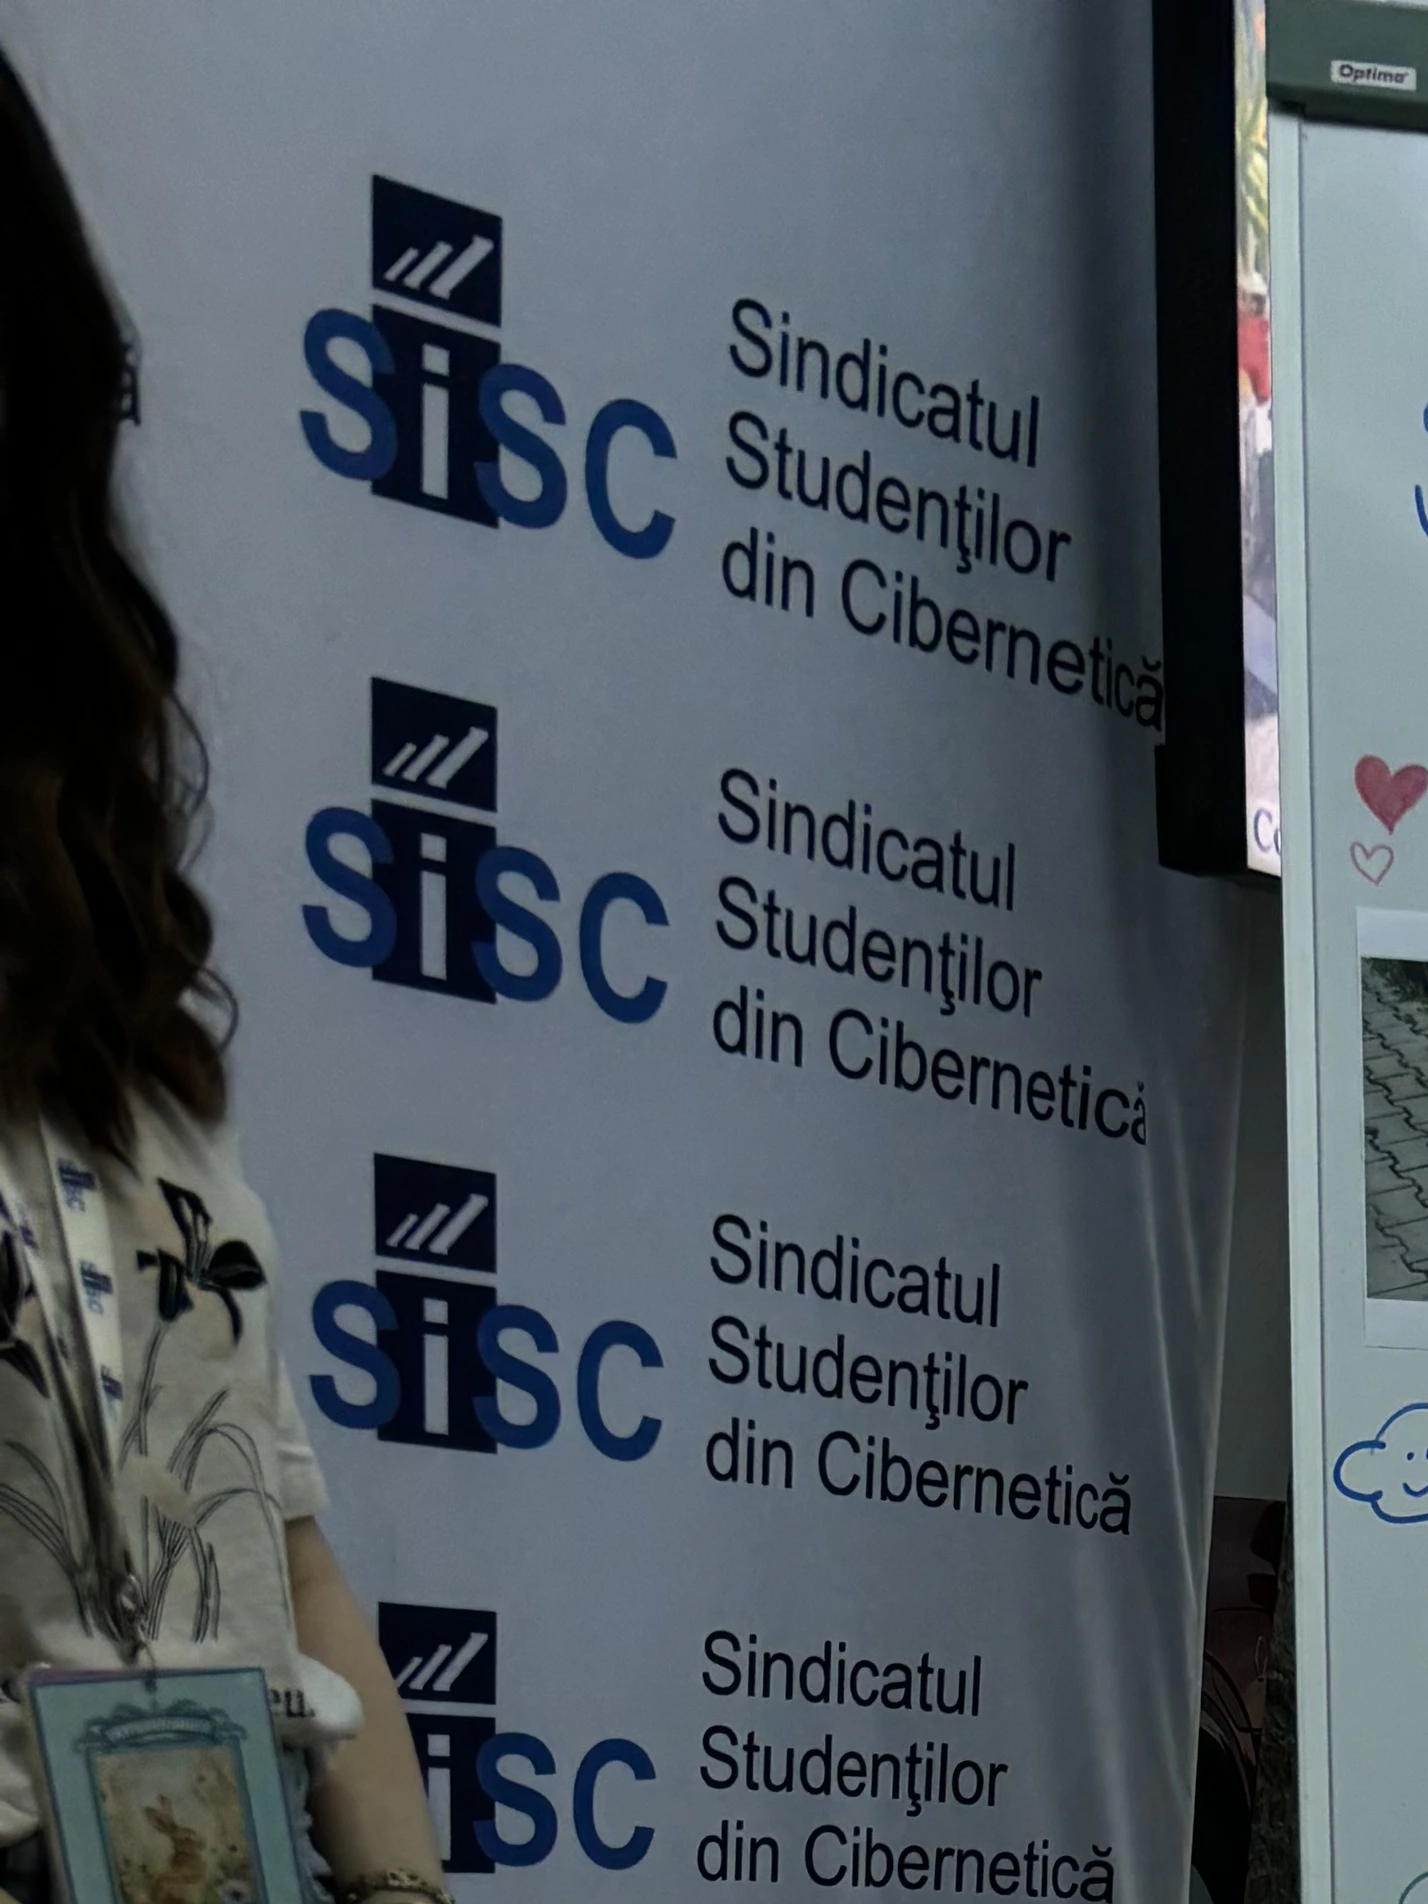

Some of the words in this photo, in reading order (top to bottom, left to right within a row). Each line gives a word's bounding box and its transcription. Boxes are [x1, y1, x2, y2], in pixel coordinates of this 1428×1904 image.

[1338, 63, 1408, 84] Optima
[729, 299, 1040, 467] Sindicatul
[720, 532, 816, 619] din
[841, 557, 1165, 733] Cibernetică
[717, 768, 1017, 911] Sindicatul
[711, 988, 804, 1069] din
[828, 1007, 1147, 1146] Cibernetică
[709, 1213, 1002, 1328] Sindicatul
[704, 1420, 794, 1489] din
[816, 1429, 1133, 1536] Cibernetică
[700, 1630, 982, 1717] Sindicatul
[425, 1715, 657, 1874] iSC
[695, 1820, 781, 1883] din
[803, 1826, 1115, 1904] Cibernetică
